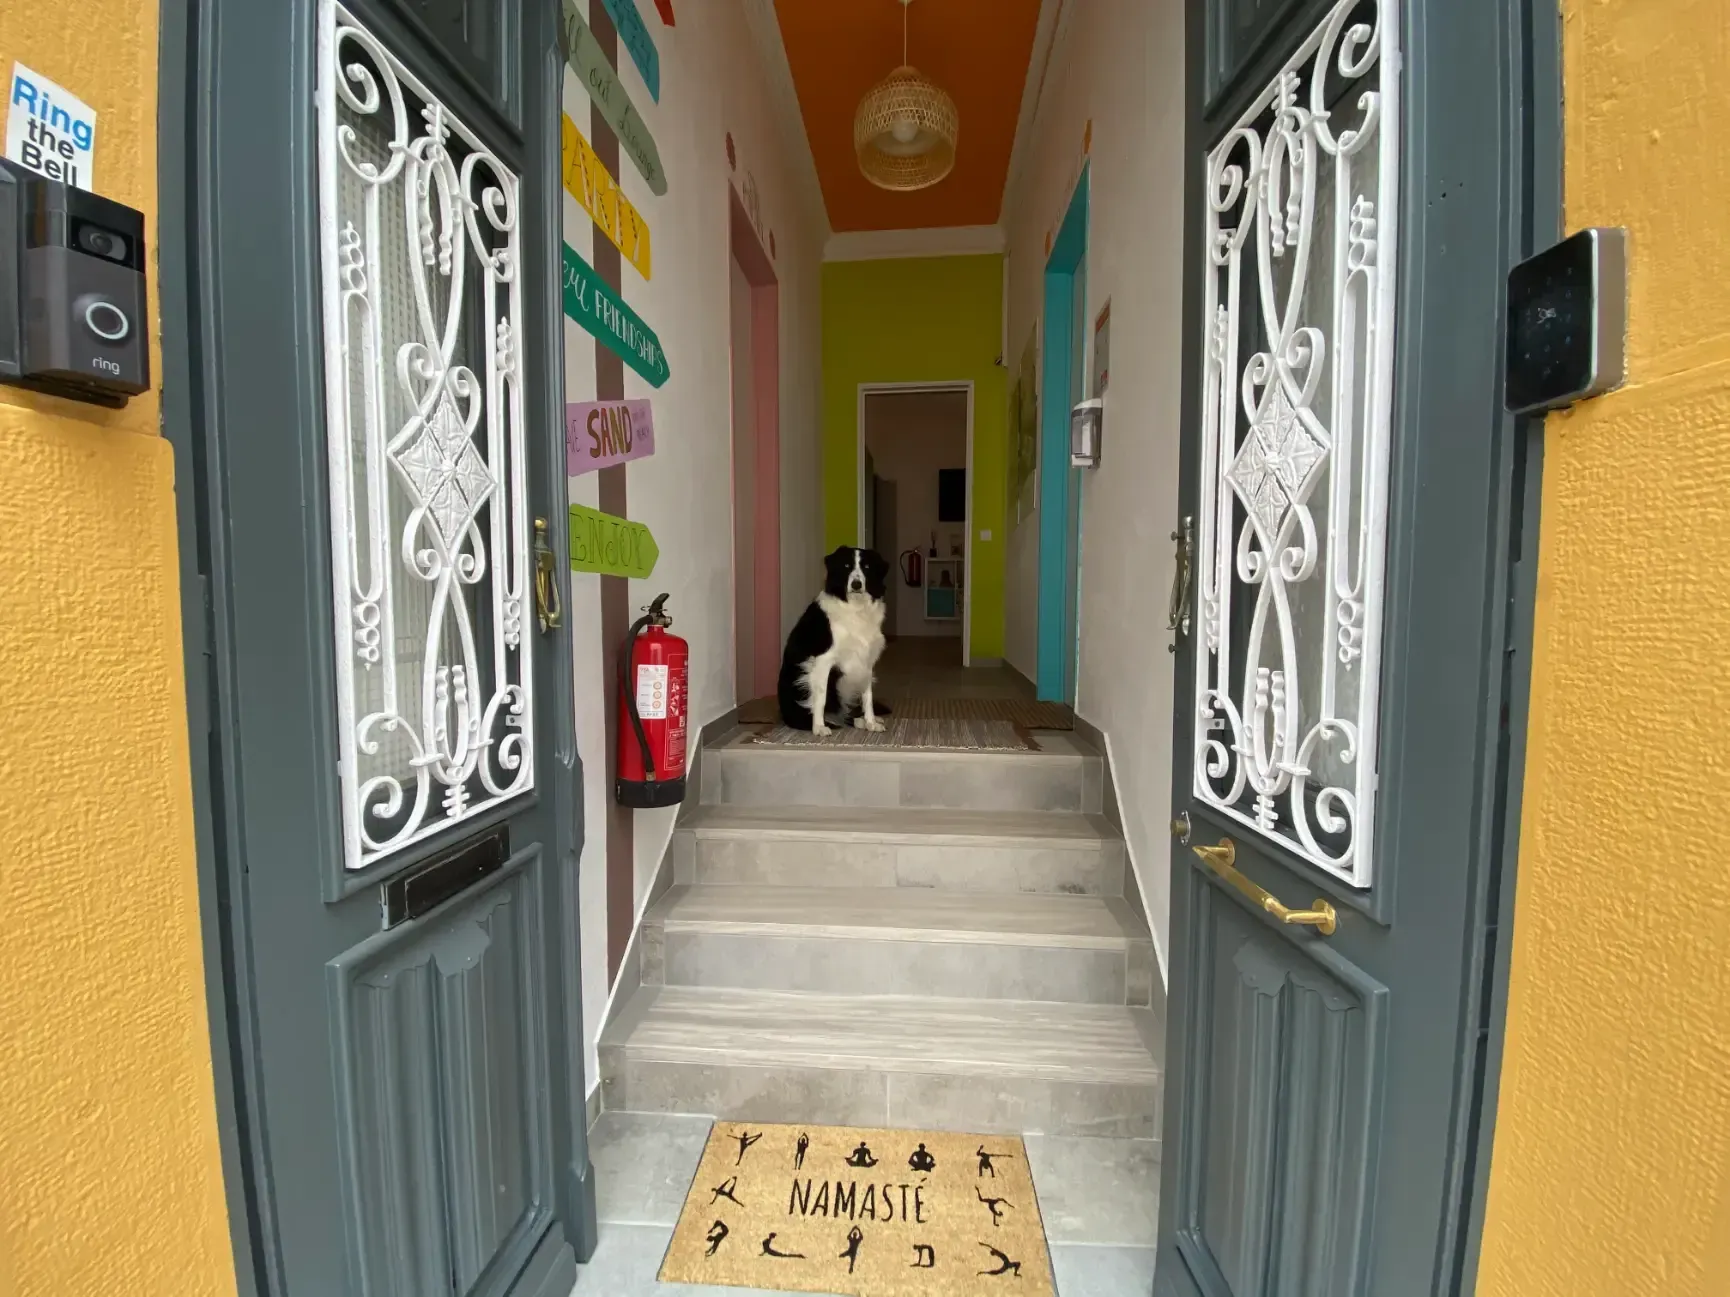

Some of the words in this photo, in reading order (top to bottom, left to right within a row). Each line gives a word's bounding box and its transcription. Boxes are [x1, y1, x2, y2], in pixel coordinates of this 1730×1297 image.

[13, 75, 92, 151] Ring
[22, 139, 77, 187] Bell
[28, 117, 74, 160] the
[563, 260, 590, 312] ew
[594, 289, 665, 377] FRIENDSHIPS
[92, 356, 120, 375] ring
[587, 406, 633, 459] SAND
[570, 512, 646, 570] ENJOY
[788, 1177, 928, 1224] NAMASTÉ
